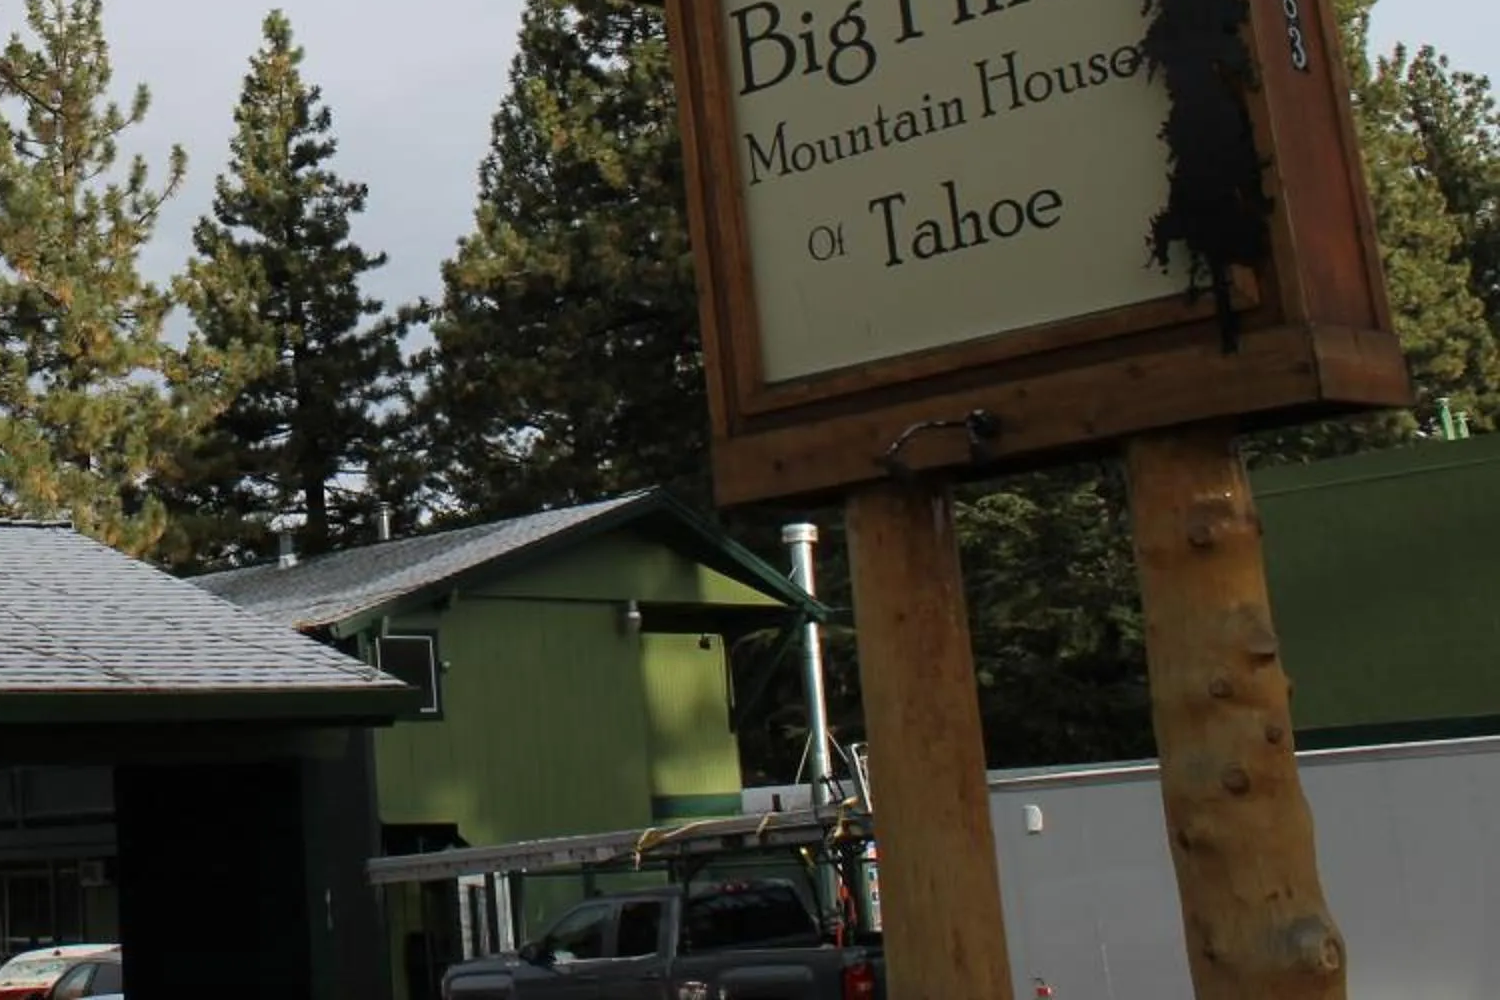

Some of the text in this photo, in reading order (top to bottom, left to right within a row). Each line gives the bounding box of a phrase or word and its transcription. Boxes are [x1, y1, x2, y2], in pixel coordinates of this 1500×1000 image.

[729, 0, 877, 97] Big
[744, 44, 1142, 187] Mountain House
[868, 180, 1064, 268] Tahoe
